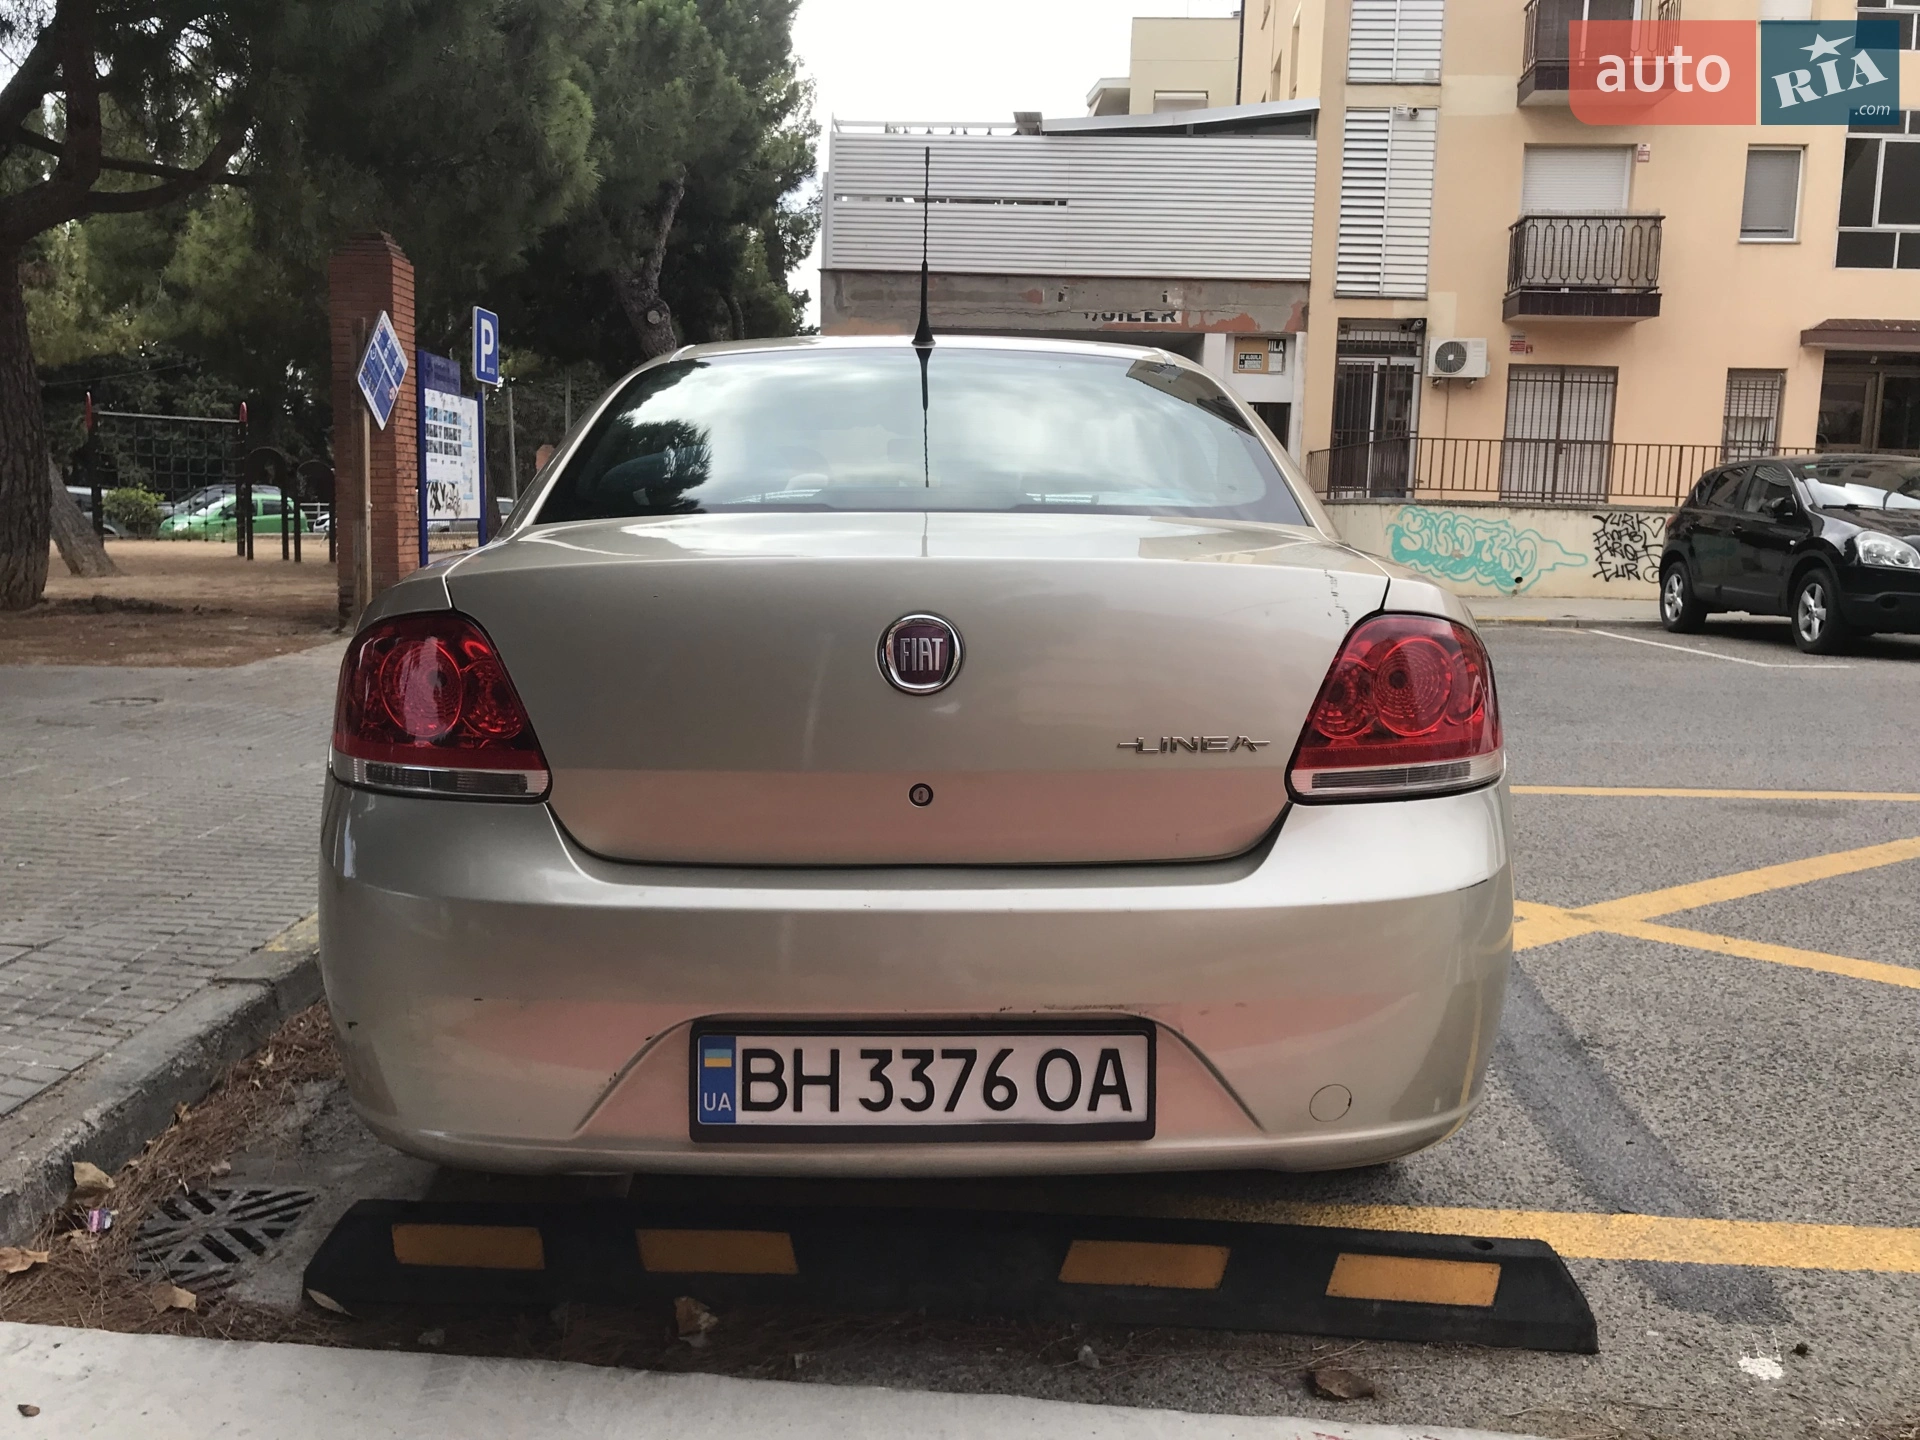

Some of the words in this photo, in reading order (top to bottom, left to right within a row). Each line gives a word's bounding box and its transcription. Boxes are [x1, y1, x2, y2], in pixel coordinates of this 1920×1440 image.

[480, 317, 495, 373] P
[900, 637, 944, 672] FIAT
[1117, 735, 1271, 754] LINEA
[741, 1048, 840, 1113] BH
[859, 1048, 1019, 1113] 3376
[1035, 1048, 1133, 1113] OA
[703, 1092, 733, 1112] UA
